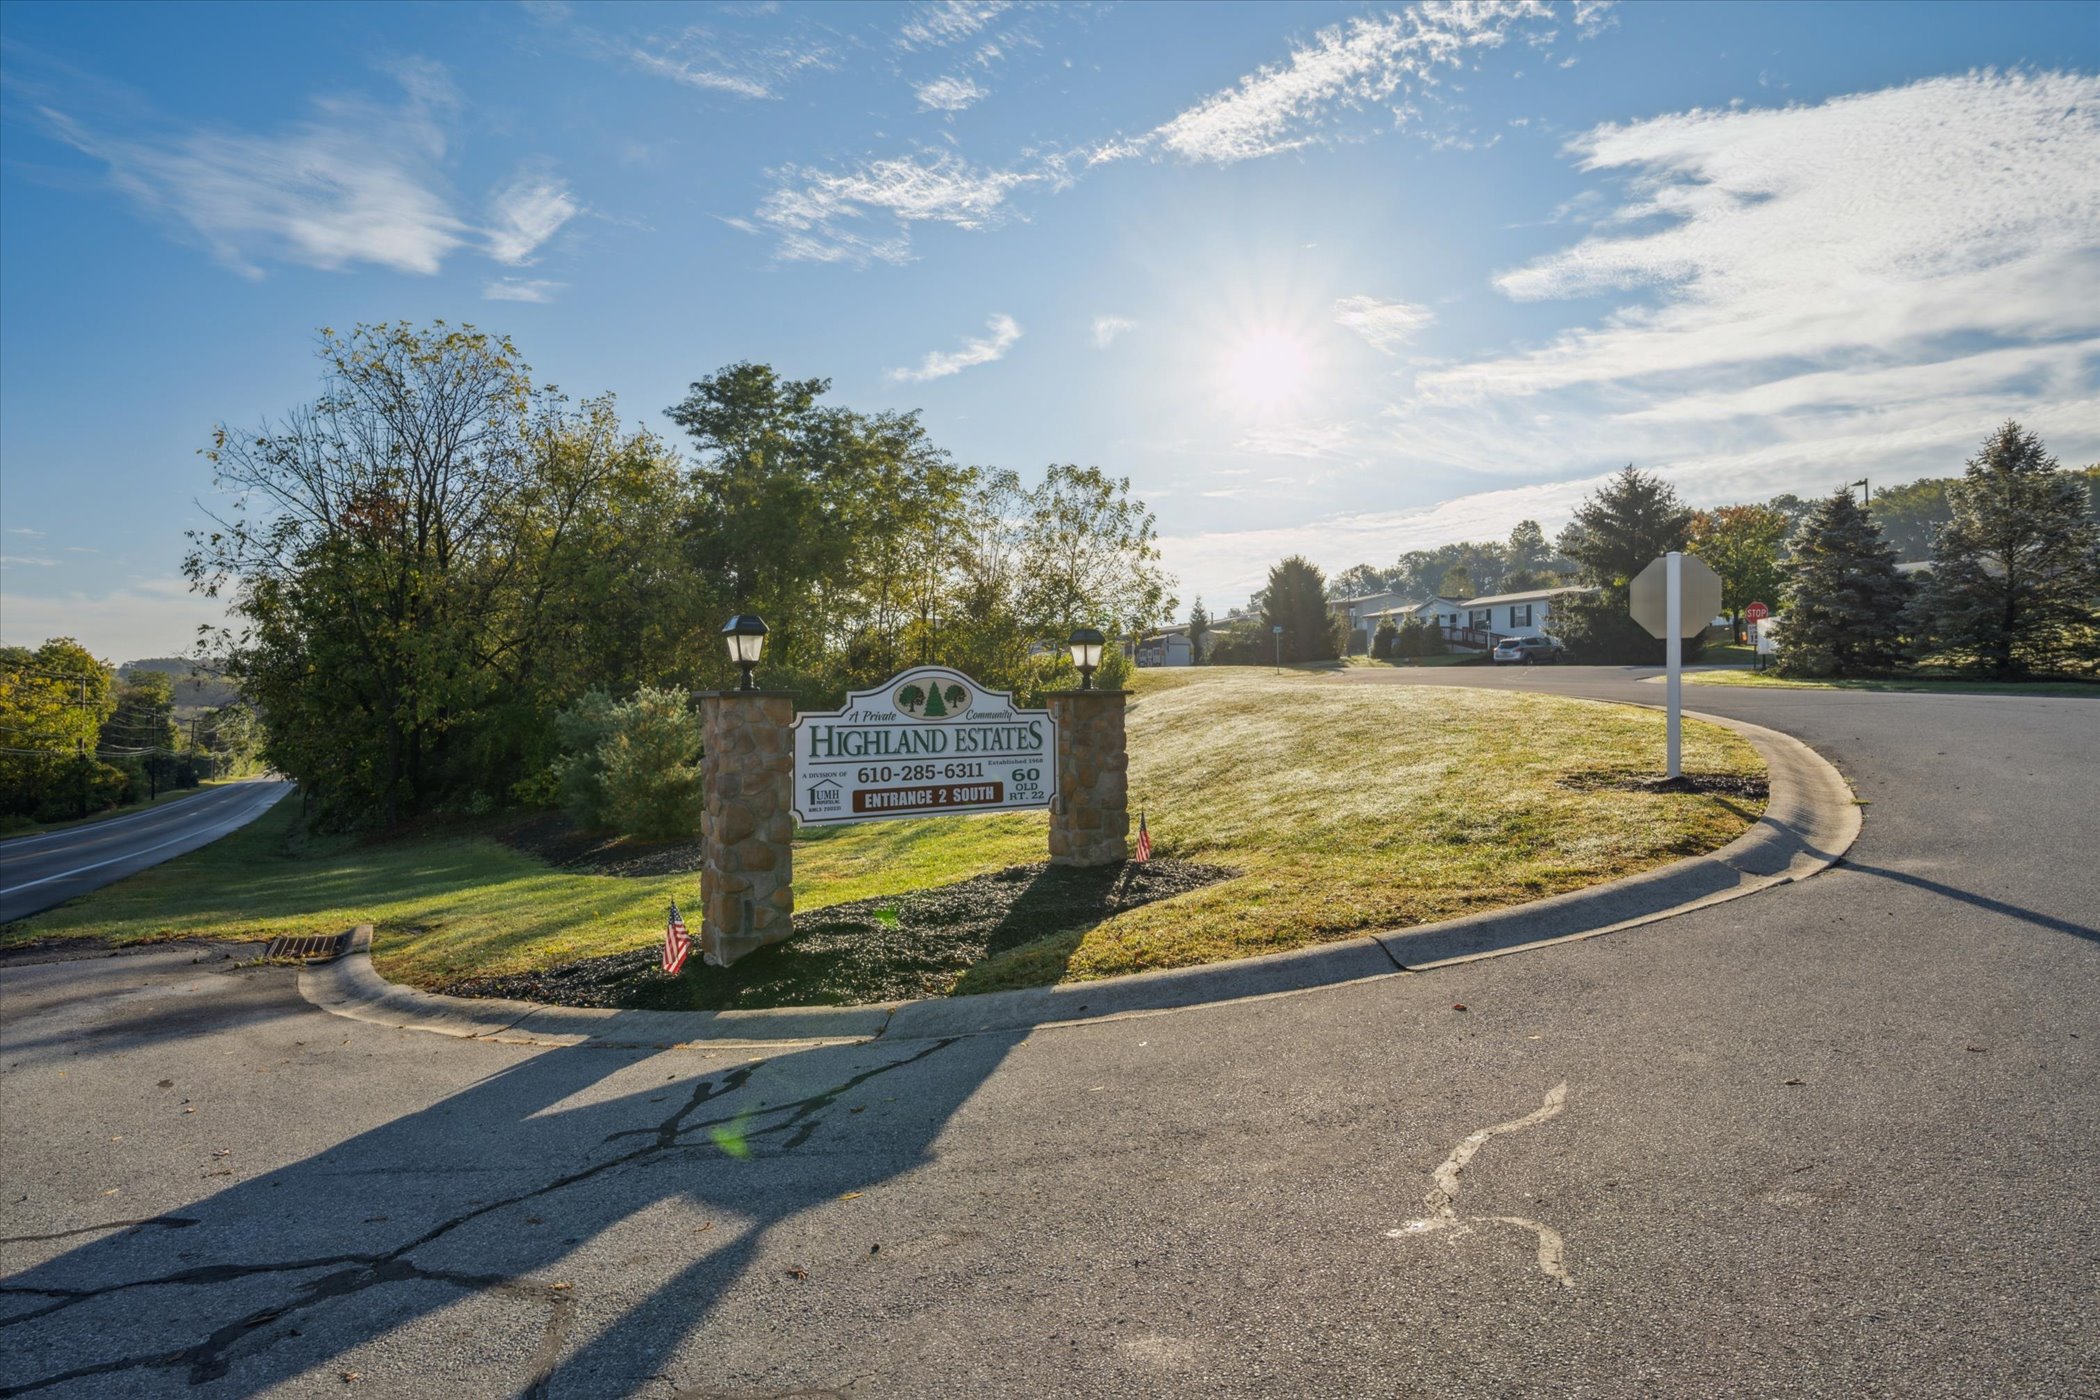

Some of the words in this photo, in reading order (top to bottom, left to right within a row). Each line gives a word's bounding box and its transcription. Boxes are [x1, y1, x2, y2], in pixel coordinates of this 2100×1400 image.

[1747, 609, 1767, 618] STOP
[848, 710, 859, 723] A
[862, 710, 897, 722] Private
[965, 709, 1013, 721] Community
[809, 771, 838, 779] DIVISION
[857, 762, 984, 784] 610-285-6311
[1011, 768, 1041, 782] 60
[1015, 783, 1039, 792] OLD
[816, 789, 840, 801] UMH
[864, 790, 933, 809] ENTRANCE
[938, 789, 948, 803] 2
[953, 786, 995, 802] SOUTH
[1009, 792, 1029, 801] RT.
[1031, 790, 1045, 800] 22
